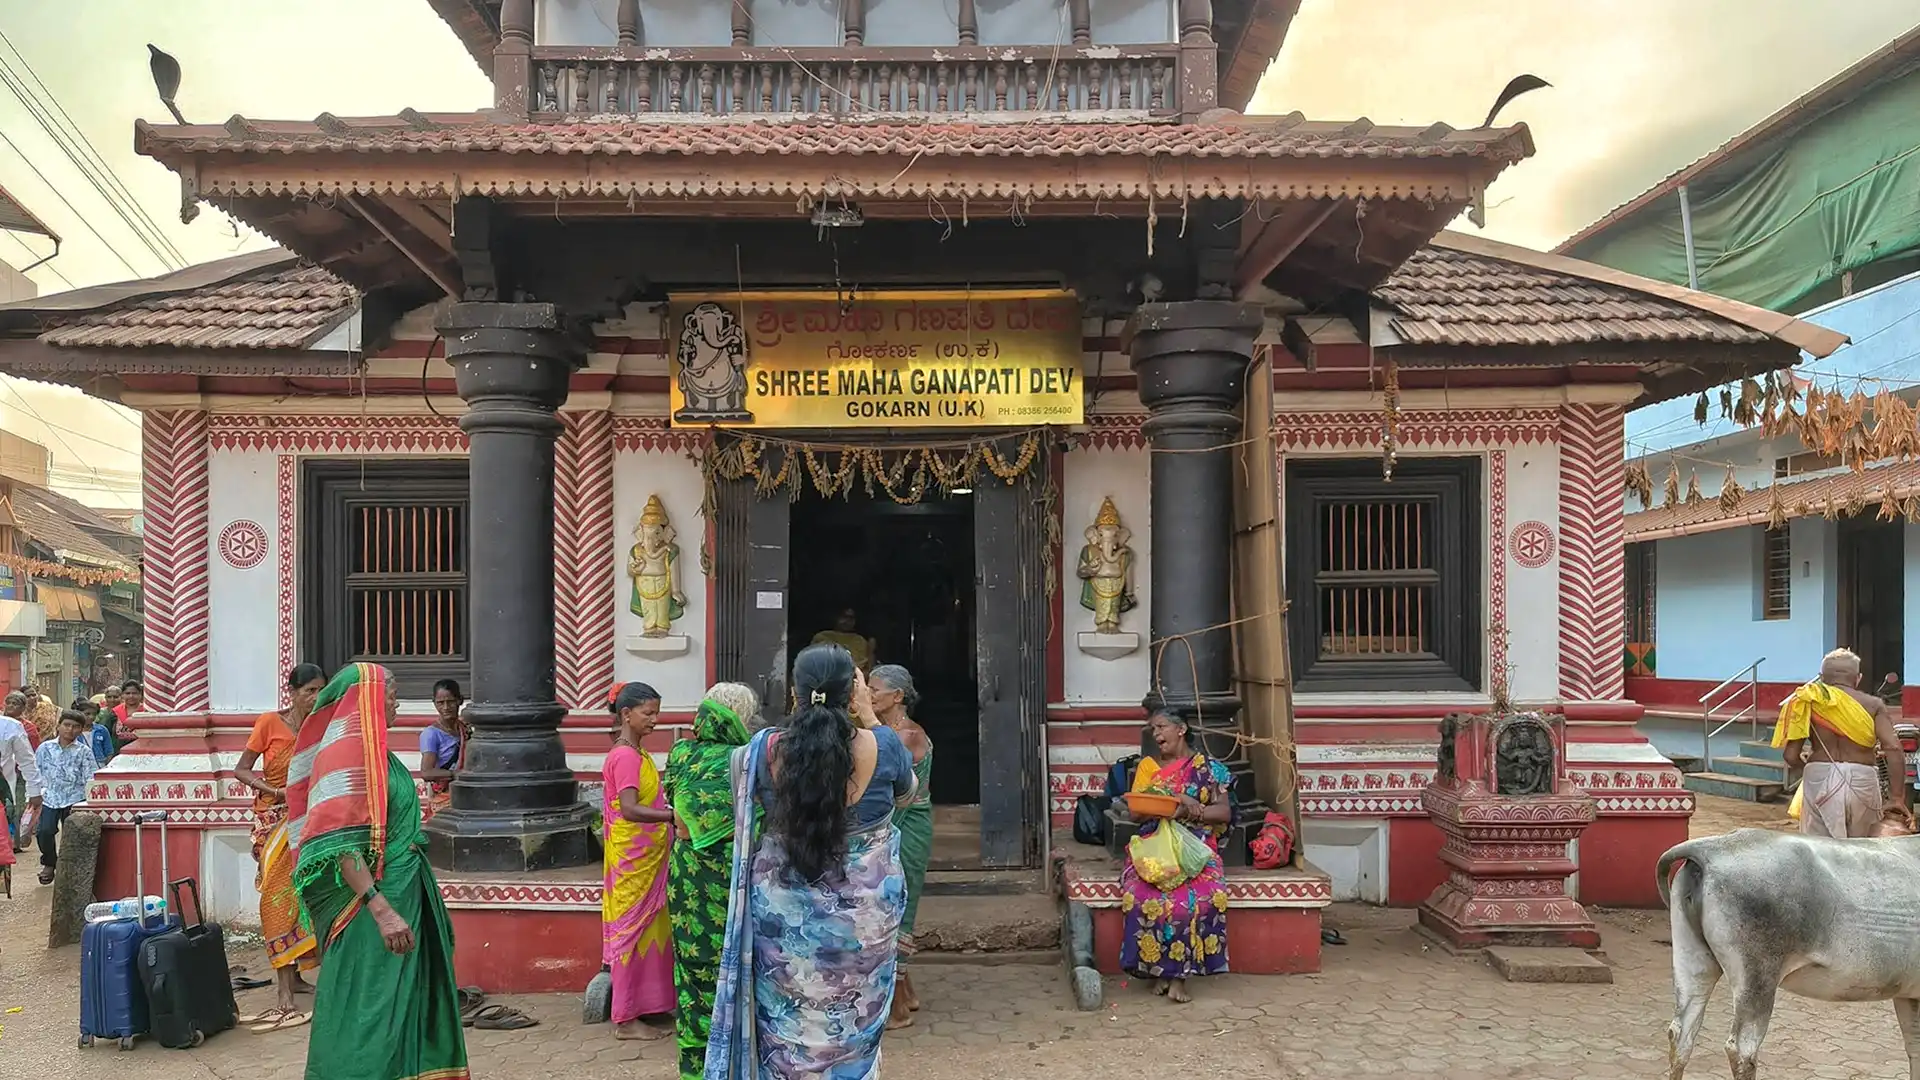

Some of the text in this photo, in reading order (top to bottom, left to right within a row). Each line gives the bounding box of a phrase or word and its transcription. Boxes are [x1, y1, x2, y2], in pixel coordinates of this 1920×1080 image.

[756, 302, 797, 347] ಶ್ರೀ
[894, 300, 995, 332] ಗಣಪತಿ
[826, 339, 1000, 360] ಗೋಕರ್ಣ (ಉ.ಕ)
[755, 367, 1074, 397] SHREE MAHA GANAPATI DEV
[846, 400, 985, 418] GOKARN (U.K)
